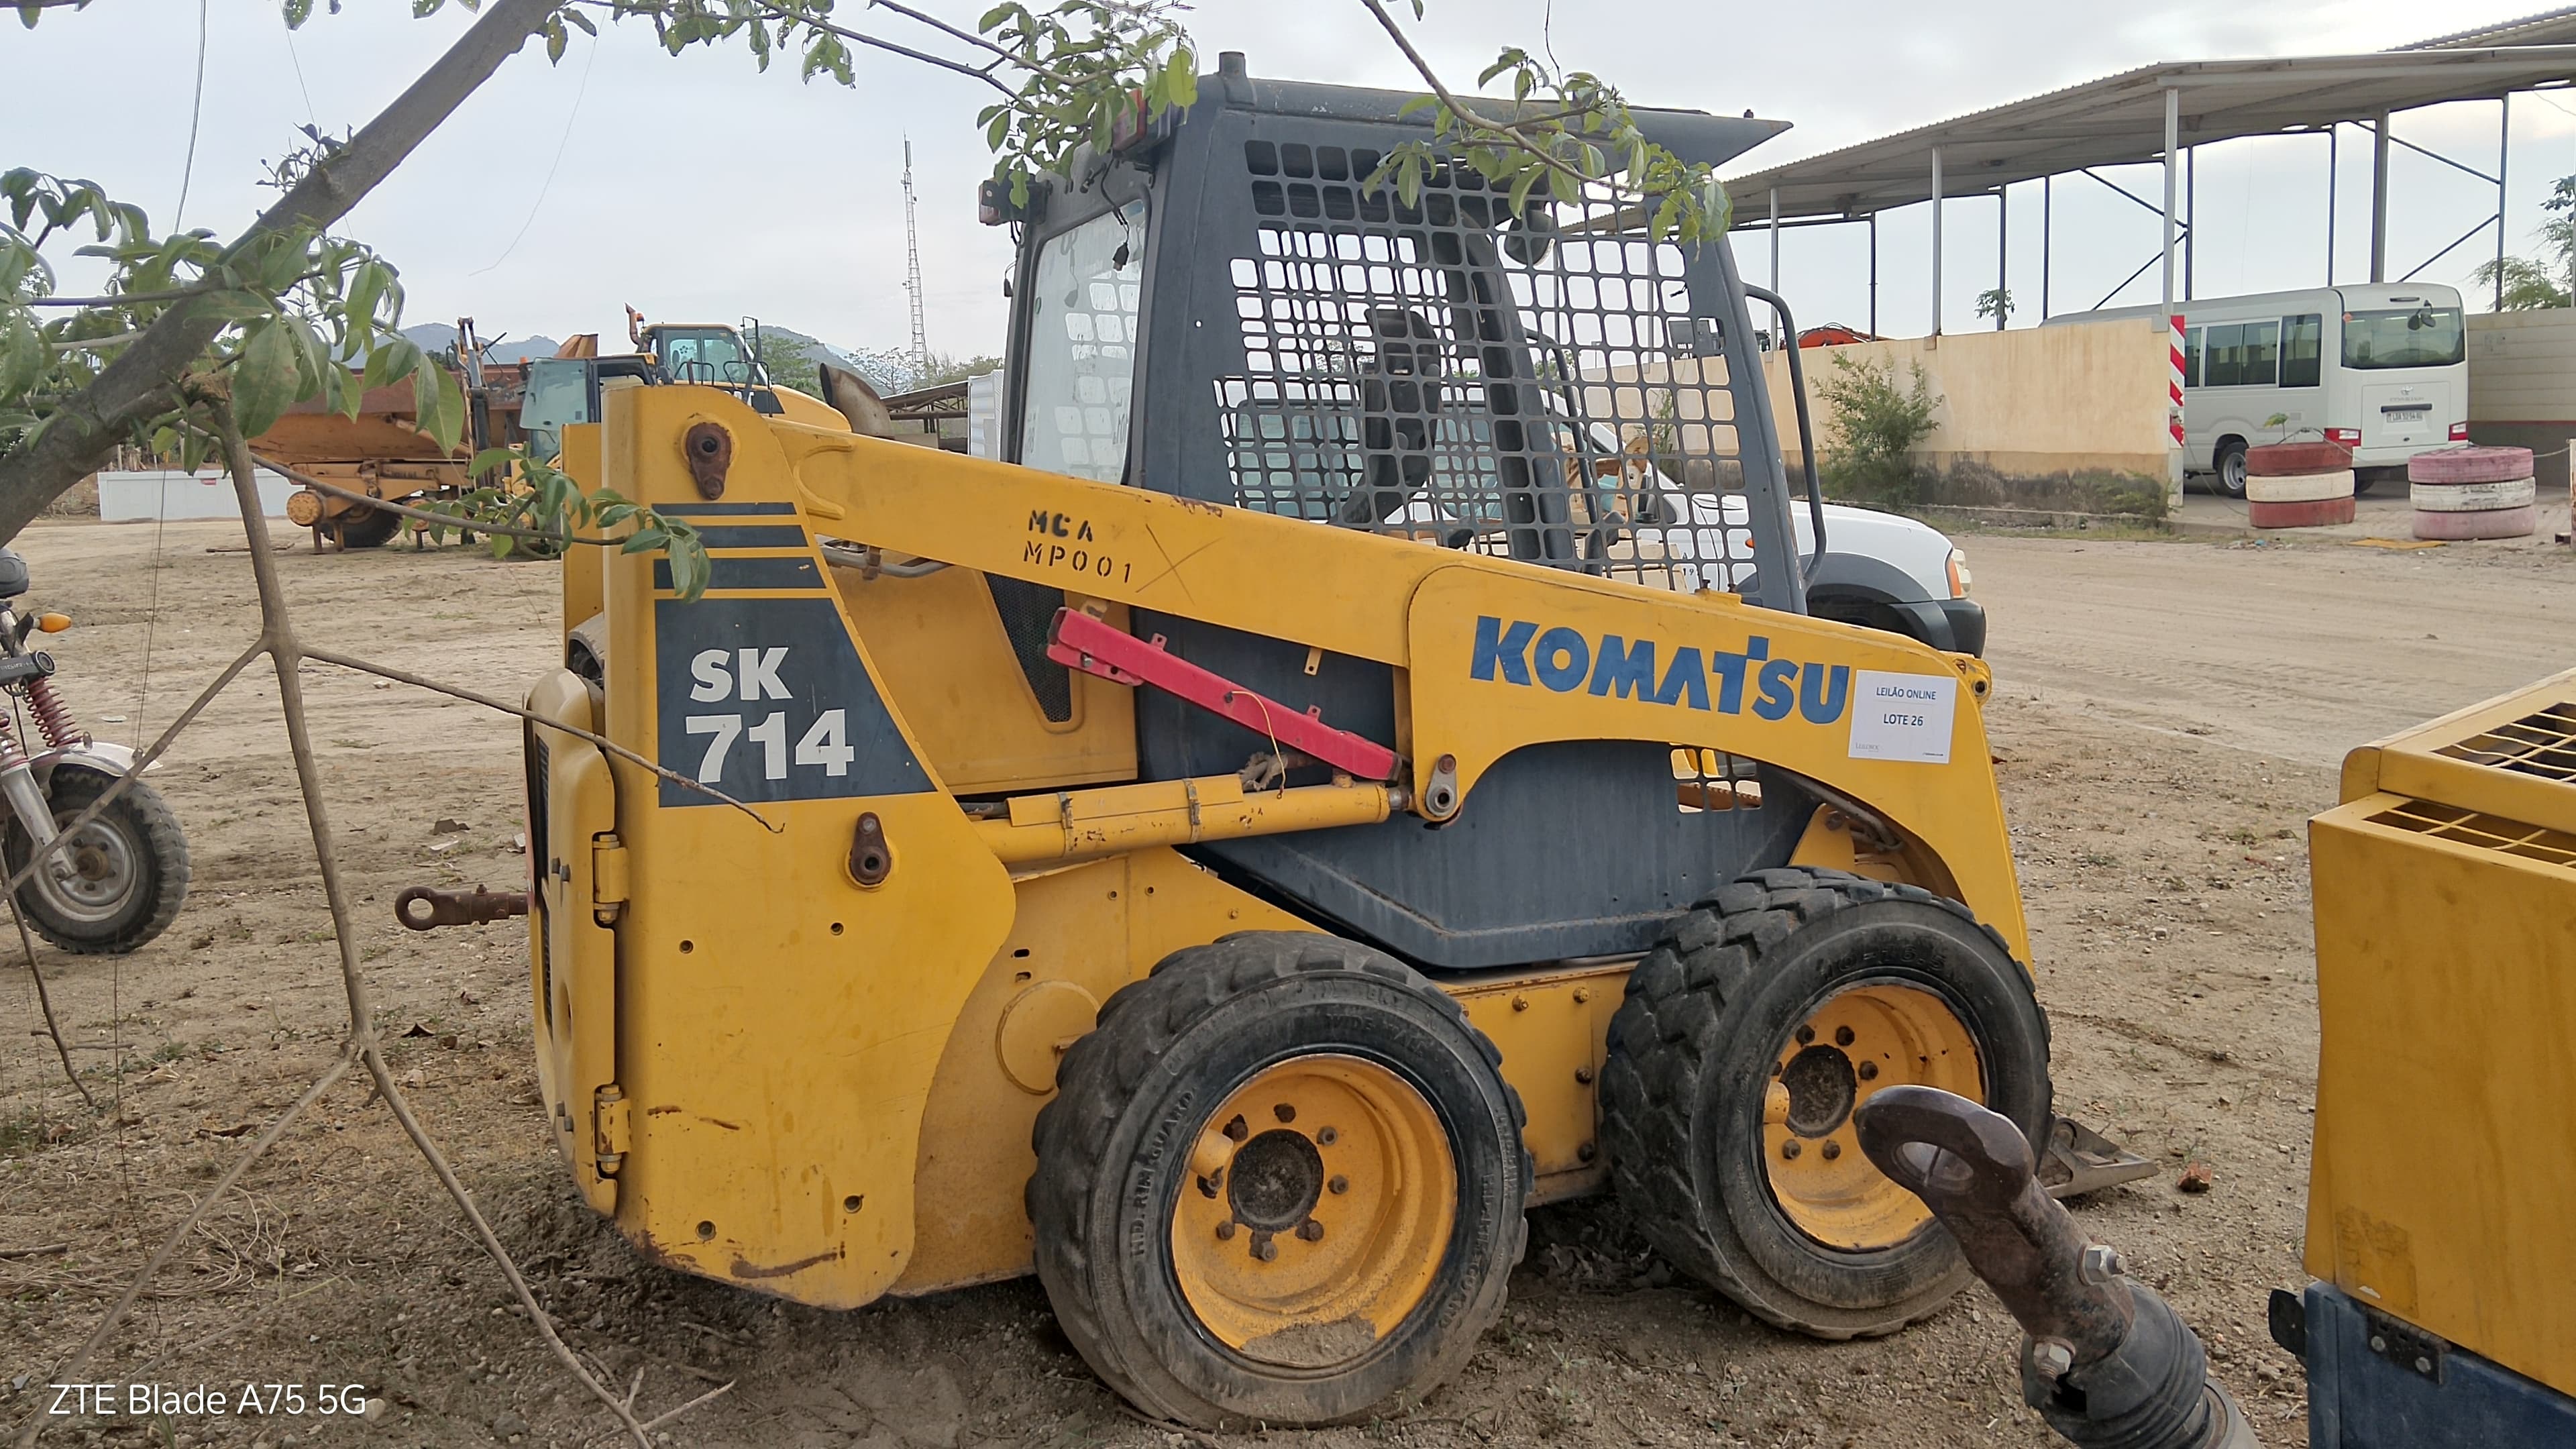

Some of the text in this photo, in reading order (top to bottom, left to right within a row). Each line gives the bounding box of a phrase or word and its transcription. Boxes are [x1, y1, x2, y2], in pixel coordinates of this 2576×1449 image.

[1028, 509, 1093, 542] MCA
[1023, 540, 1132, 584] MP001
[690, 647, 793, 703] SK
[1470, 615, 1850, 724] KOMATSU
[1876, 686, 1937, 700] LEILÃO ONLINE
[1884, 713, 1924, 726] LOTE 26
[686, 708, 855, 784] 714
